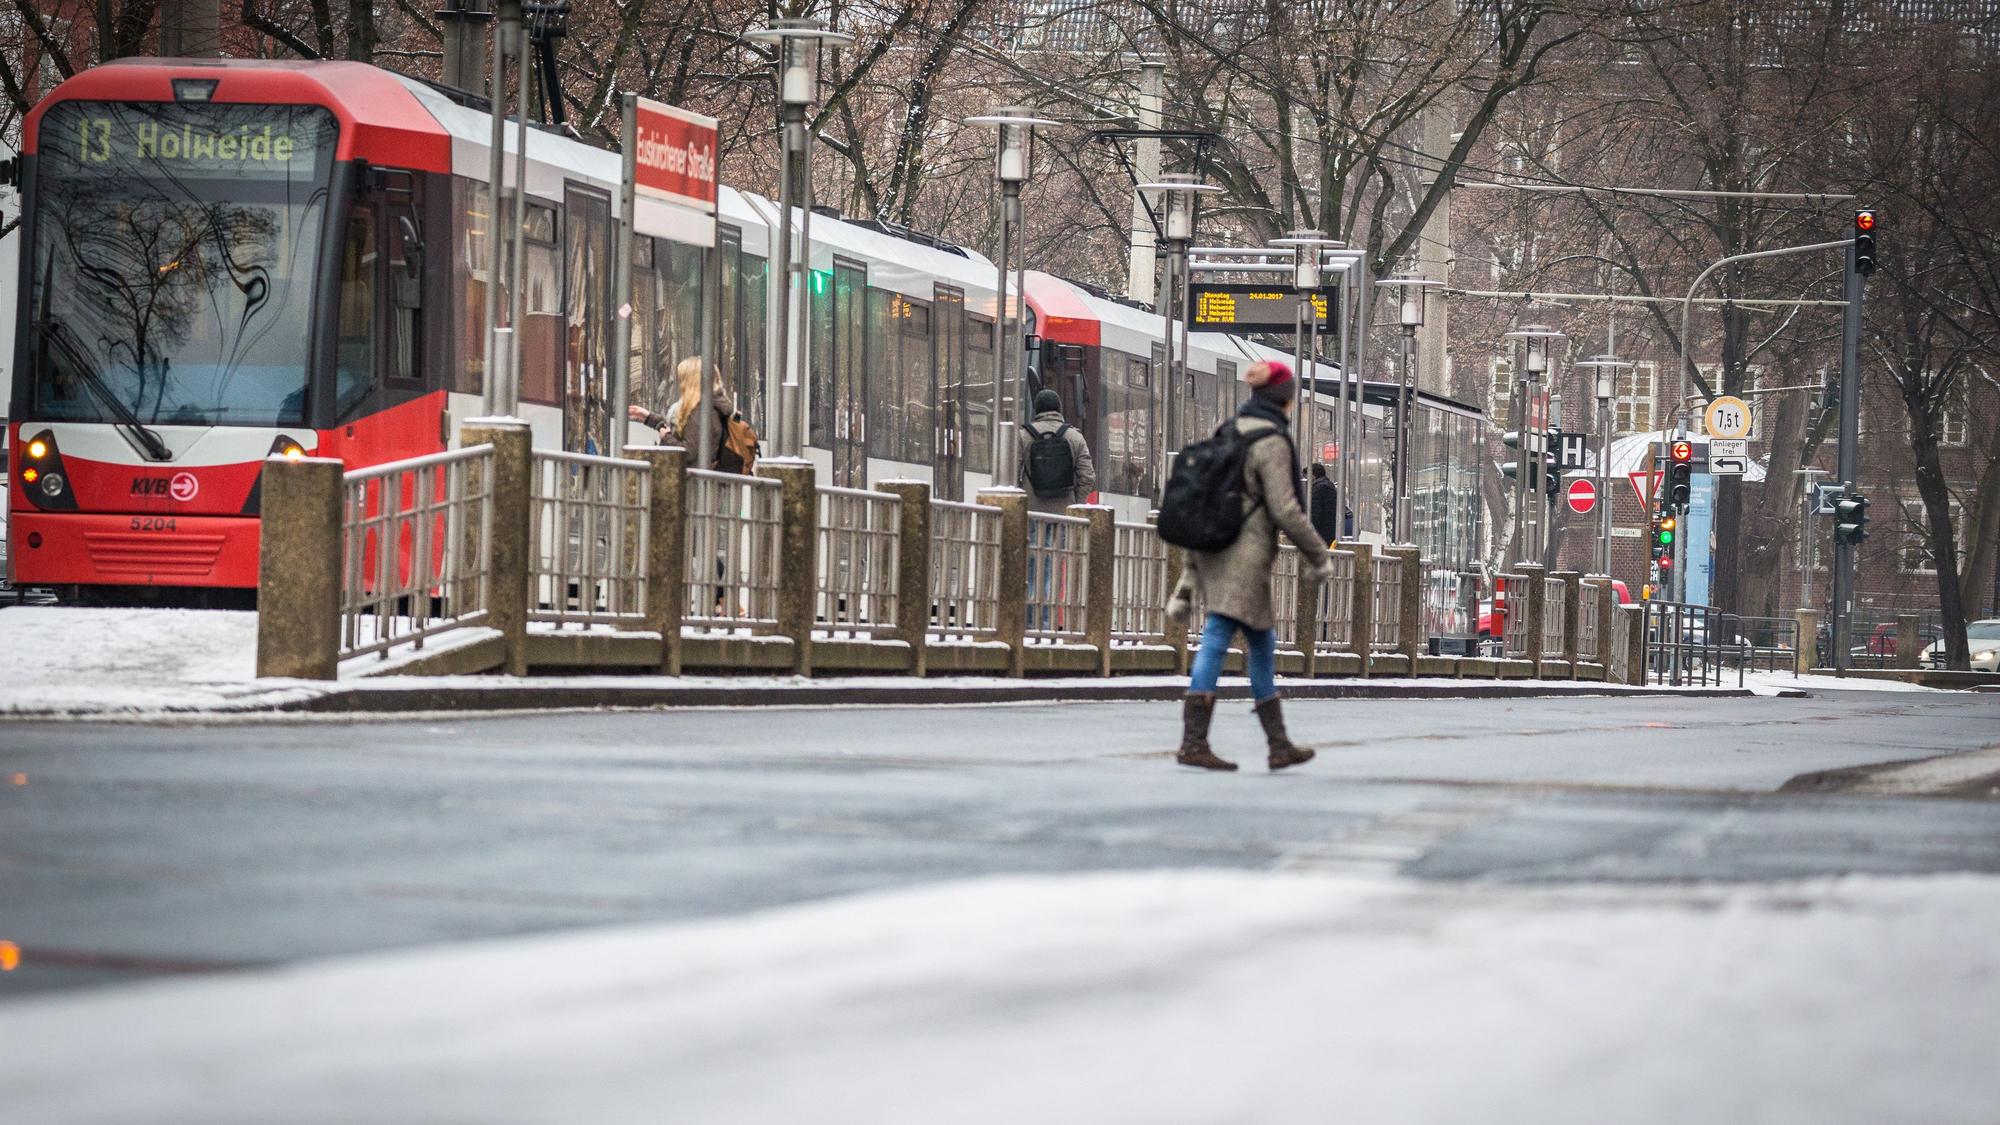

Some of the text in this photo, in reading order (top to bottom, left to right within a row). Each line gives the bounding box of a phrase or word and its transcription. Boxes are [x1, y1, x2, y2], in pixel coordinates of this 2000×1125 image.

[79, 118, 293, 162] 13 Holweide
[637, 126, 714, 182] Euskirchener Straße
[1249, 292, 1284, 300] 24.01.2017
[1717, 410, 1739, 430] 7,5 t
[1562, 436, 1583, 466] H
[1713, 441, 1743, 450] Anlieger
[130, 478, 169, 494] KVB
[130, 517, 176, 532] 5204
